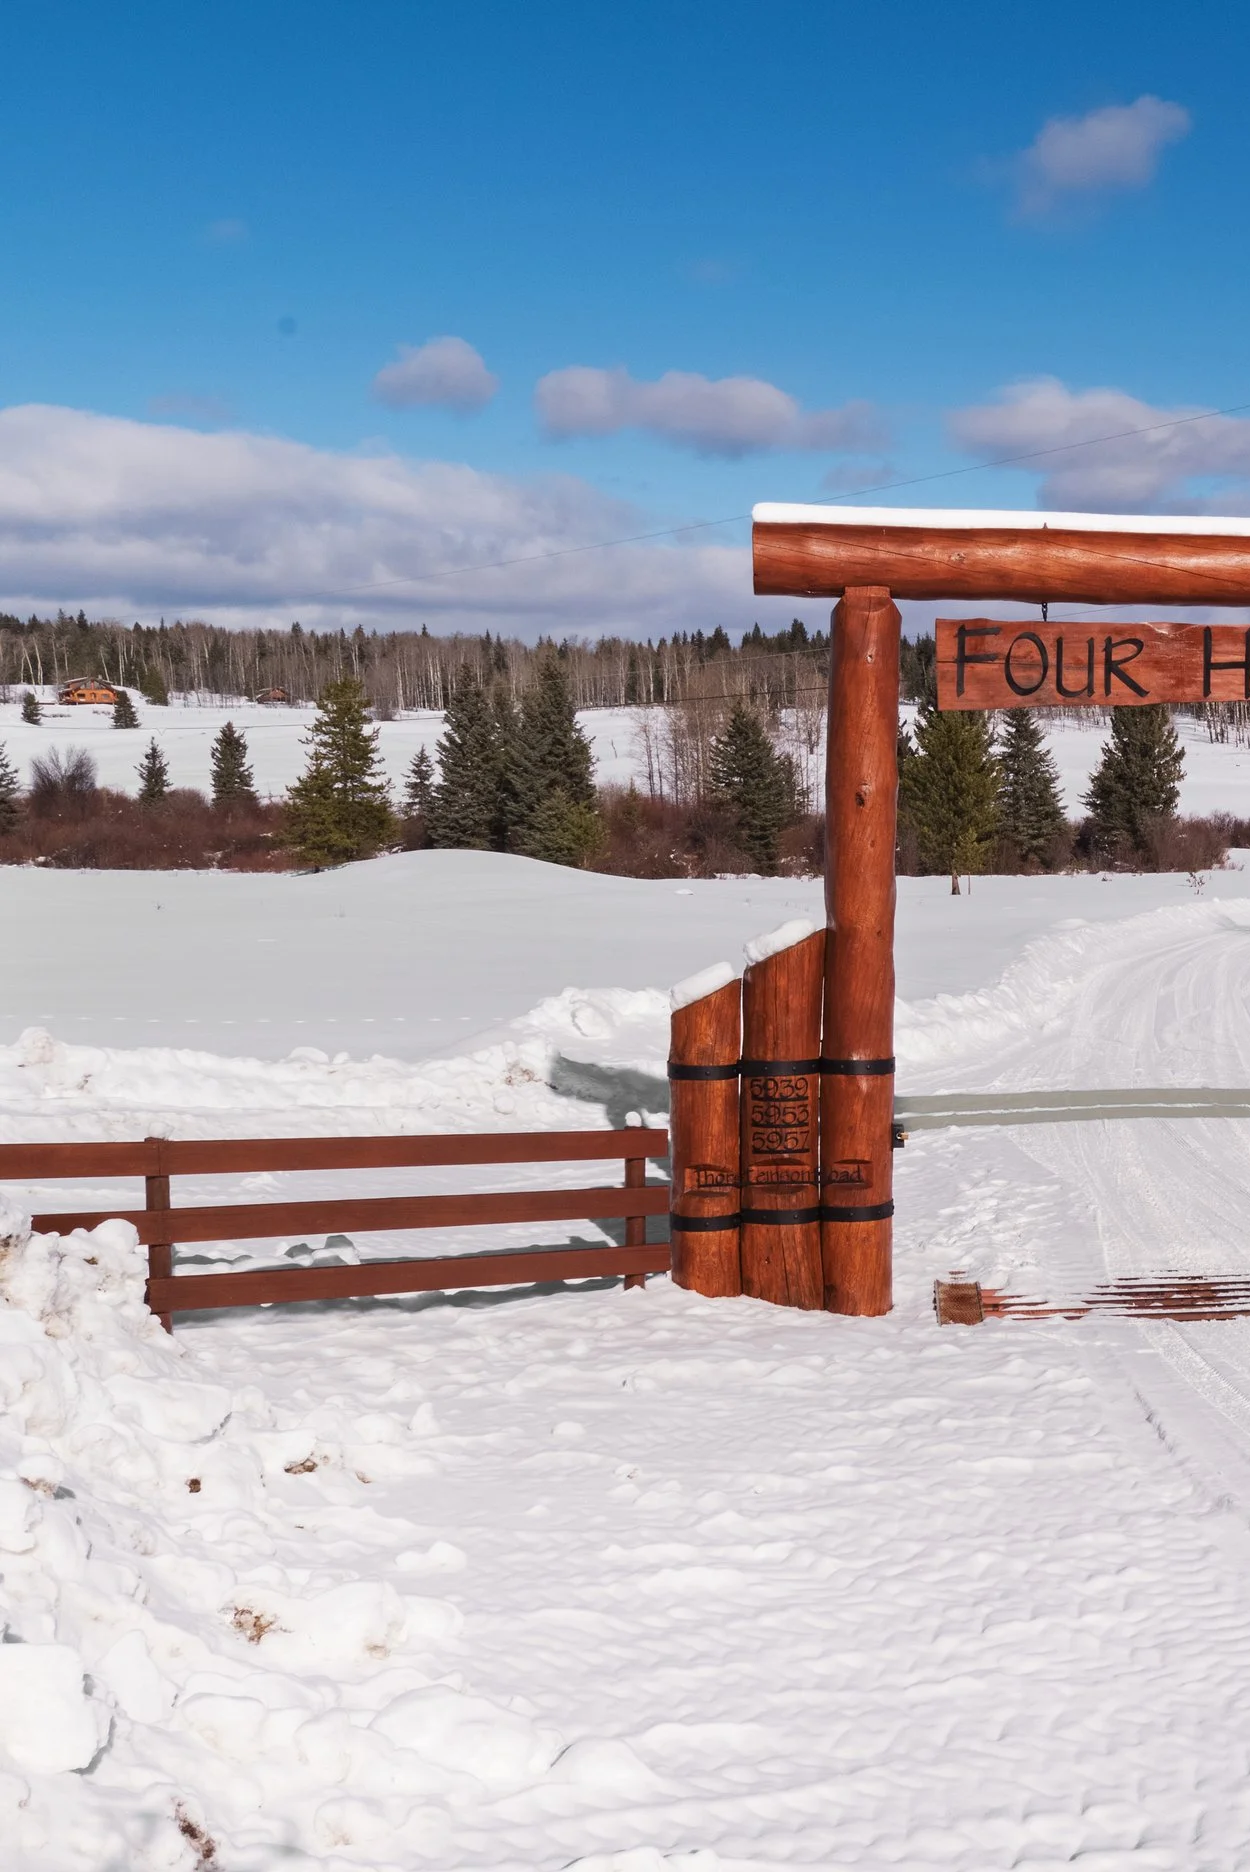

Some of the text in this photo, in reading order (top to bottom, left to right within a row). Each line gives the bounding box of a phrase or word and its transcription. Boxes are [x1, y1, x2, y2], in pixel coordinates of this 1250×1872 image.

[956, 624, 1150, 698] FOUR
[750, 1077, 808, 1098] 5939
[752, 1104, 809, 1124] 5953
[752, 1130, 810, 1150] 5957
